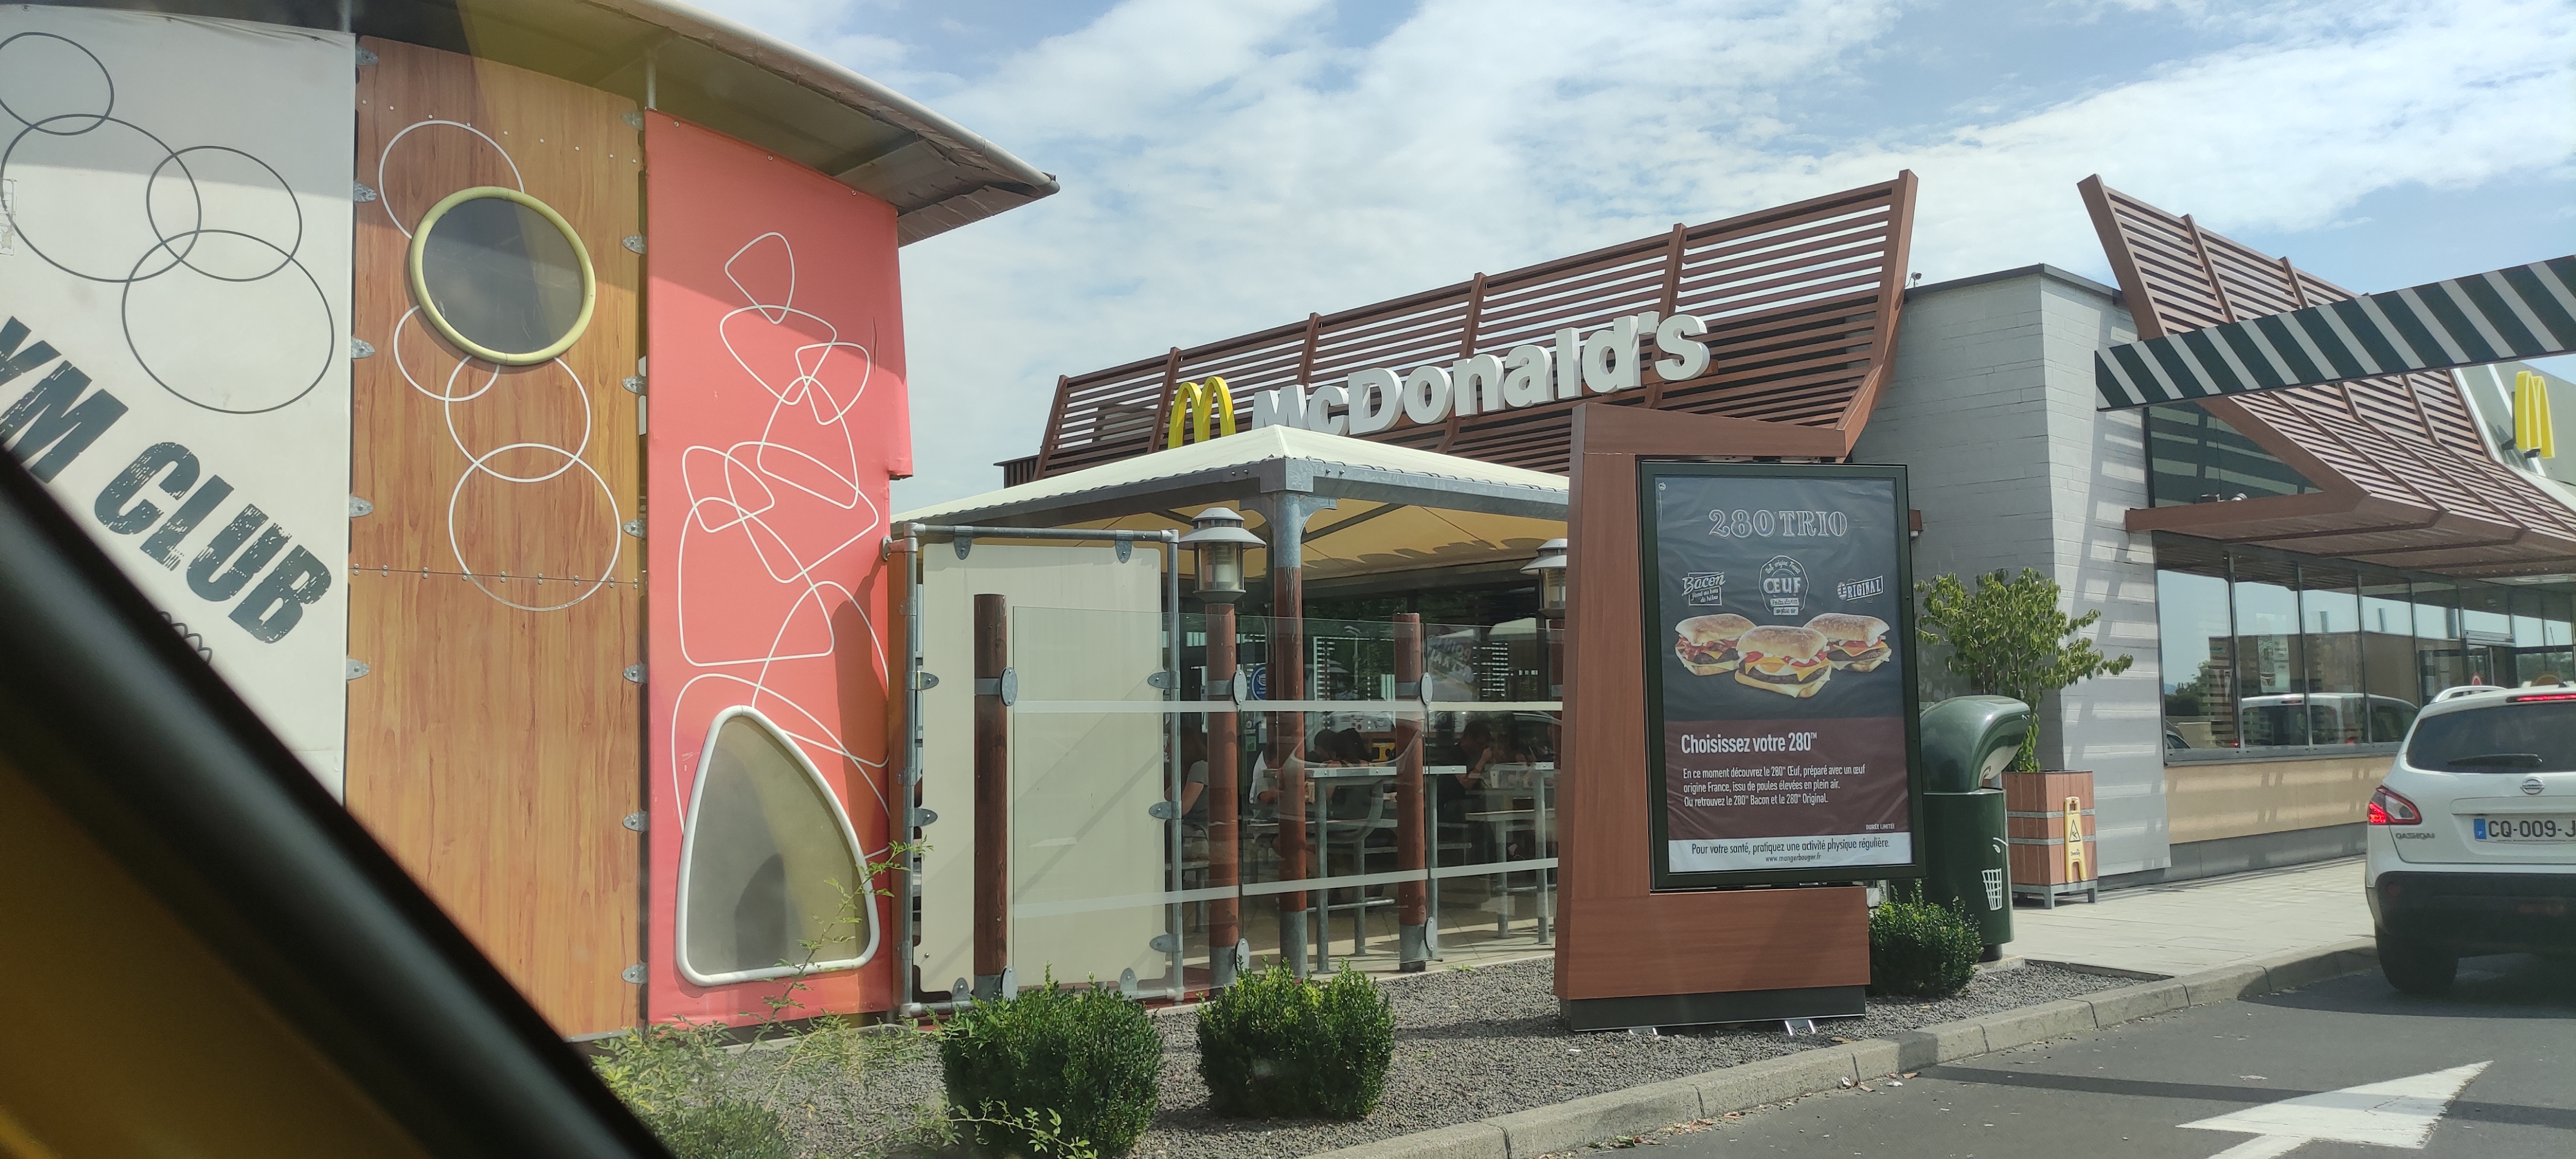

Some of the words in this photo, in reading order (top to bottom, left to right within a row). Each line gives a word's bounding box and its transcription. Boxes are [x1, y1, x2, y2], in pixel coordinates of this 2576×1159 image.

[1252, 311, 1711, 437] McDonald's
[1778, 510, 1847, 538] TRIO
[94, 442, 332, 644] CLUB
[1681, 574, 1726, 597] Bacon
[1764, 577, 1801, 594] ŒUF
[1837, 579, 1881, 601] ORIGINAL
[1681, 734, 1750, 754] Choisissez
[1753, 734, 1786, 753] votre
[1682, 768, 1692, 779] En
[1693, 770, 1701, 778] ce
[1702, 767, 1730, 778] moment
[1731, 766, 1763, 777] découvrez
[1764, 766, 1770, 777] le
[1787, 765, 1802, 777] Œuf,
[1803, 764, 1828, 778] préparé
[1828, 766, 1843, 776] avec
[1843, 766, 1852, 775] un
[1853, 763, 1866, 774] œuf
[1684, 782, 1707, 795] origine
[1708, 781, 1732, 793] France,
[1732, 781, 1746, 792] issu
[1747, 781, 1755, 791] de
[1757, 780, 1778, 793] poules
[1778, 779, 1803, 790] élevées
[1804, 781, 1812, 789] en
[1813, 778, 1829, 792] plein
[1830, 778, 1841, 789] air.
[1684, 796, 1693, 807] Ou
[1695, 797, 1725, 807] retrouvez
[1726, 795, 1732, 806] le
[1750, 795, 1769, 805] Bacon
[1770, 794, 1778, 804] et
[1778, 793, 1785, 804] le
[1802, 792, 1828, 806] Original.
[1692, 843, 1708, 854] Pour
[1710, 844, 1728, 854] votre
[1730, 842, 1751, 855] santé,
[1753, 842, 1785, 855] pratiquez
[1787, 842, 1800, 851] une
[1801, 839, 1826, 851] activité
[1827, 838, 1857, 853] physique
[1858, 836, 1891, 851] régulière.
[1765, 852, 1822, 863] www.mangerbouger.fr
